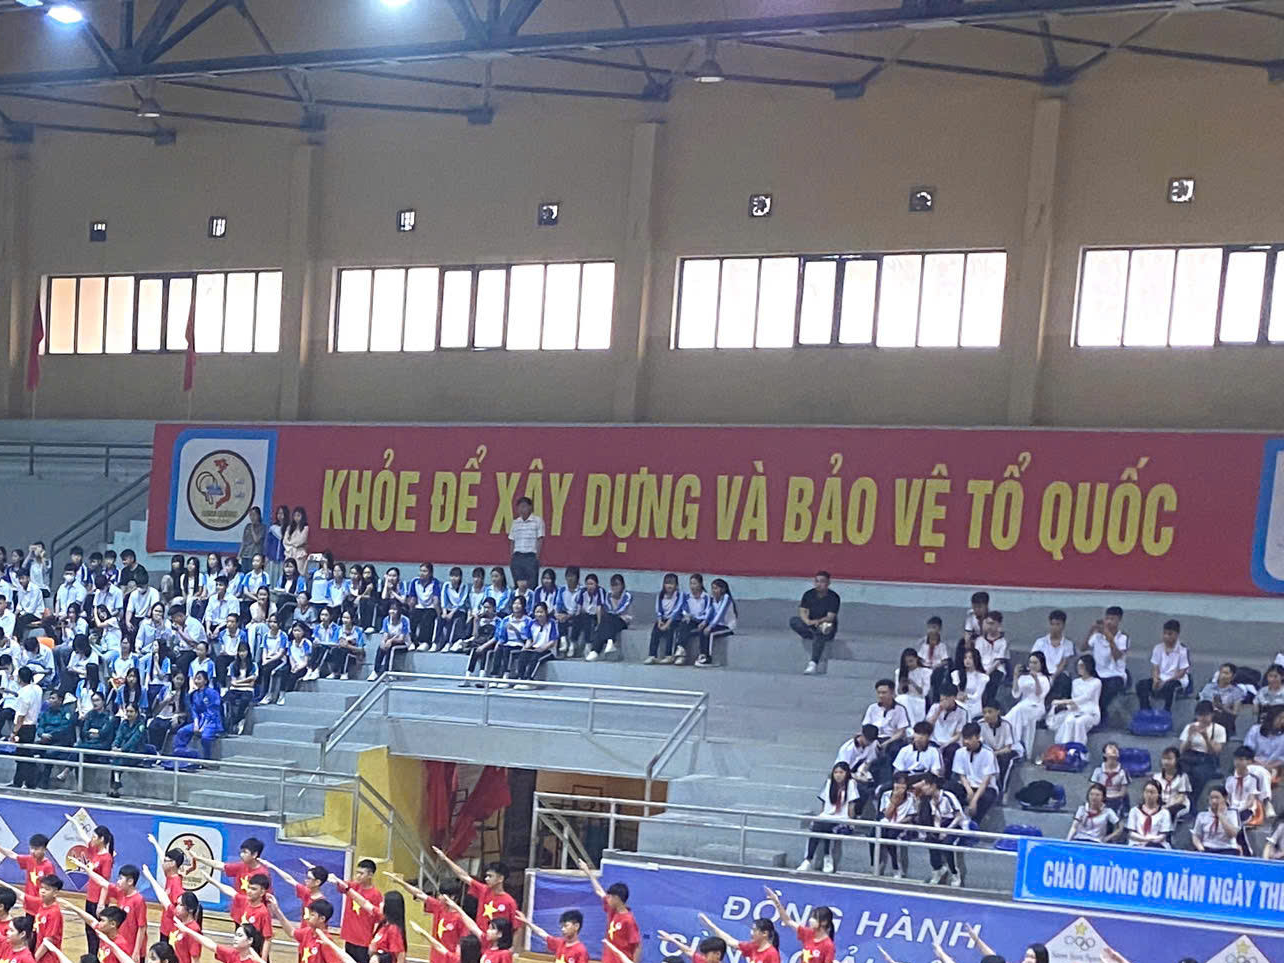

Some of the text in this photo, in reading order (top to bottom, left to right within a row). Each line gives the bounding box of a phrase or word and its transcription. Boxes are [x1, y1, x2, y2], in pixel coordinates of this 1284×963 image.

[320, 448, 420, 532] KHỎE
[430, 444, 488, 534] ĐỂ
[582, 466, 701, 553] DỰNG
[716, 460, 769, 543] VÀ
[782, 453, 878, 546] BẢO
[894, 463, 951, 564] VỆ
[966, 451, 1032, 552] TỔ
[1038, 456, 1178, 561] QUỐC
[1042, 857, 1086, 891] CHÀO
[1089, 860, 1139, 896] MỪNG
[1141, 870, 1163, 899] 80
[1165, 867, 1205, 903] NĂM
[1208, 872, 1256, 909] NGÀY
[856, 908, 982, 949] HÀNH
